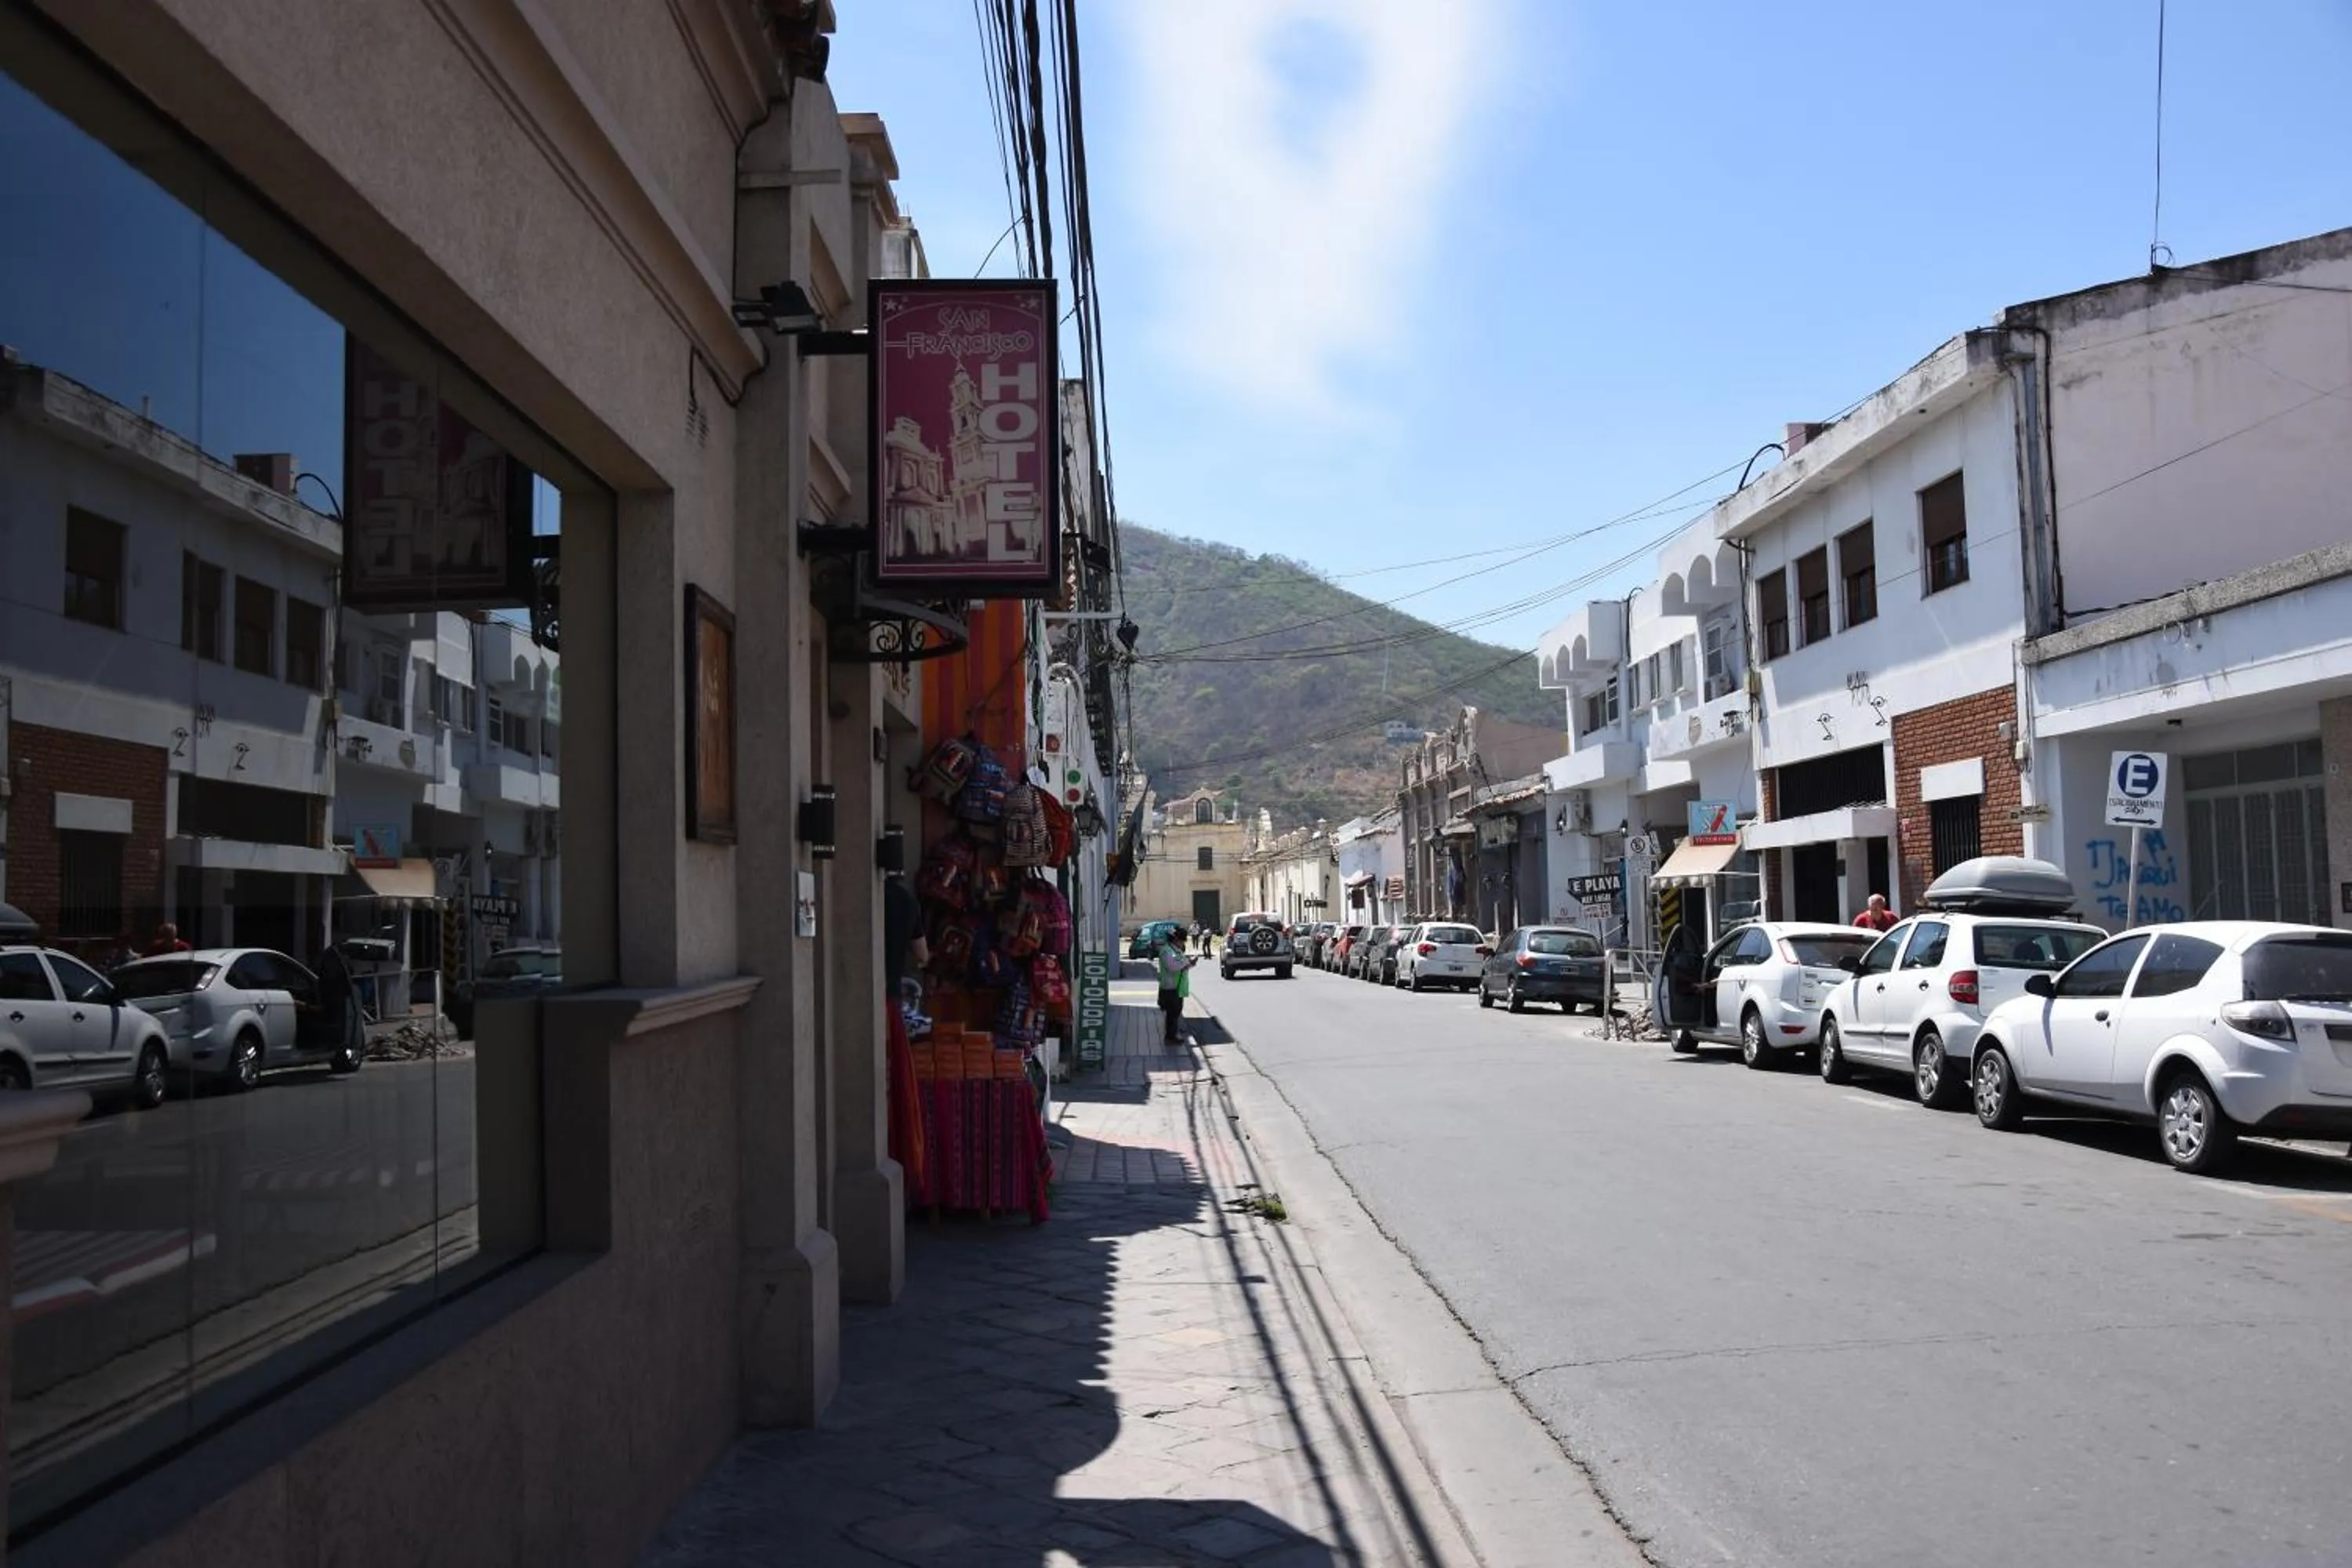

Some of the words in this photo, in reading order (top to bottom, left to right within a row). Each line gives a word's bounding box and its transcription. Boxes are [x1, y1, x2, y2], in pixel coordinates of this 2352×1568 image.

[938, 305, 991, 333] SAN
[906, 330, 1034, 361] FRANCISCO
[978, 362, 1039, 562] HOTEL
[2125, 757, 2151, 794] E
[1584, 875, 1621, 893] PLAYA
[2136, 895, 2185, 924] AMO
[1081, 955, 1106, 1061] FOTOCOPIAS
